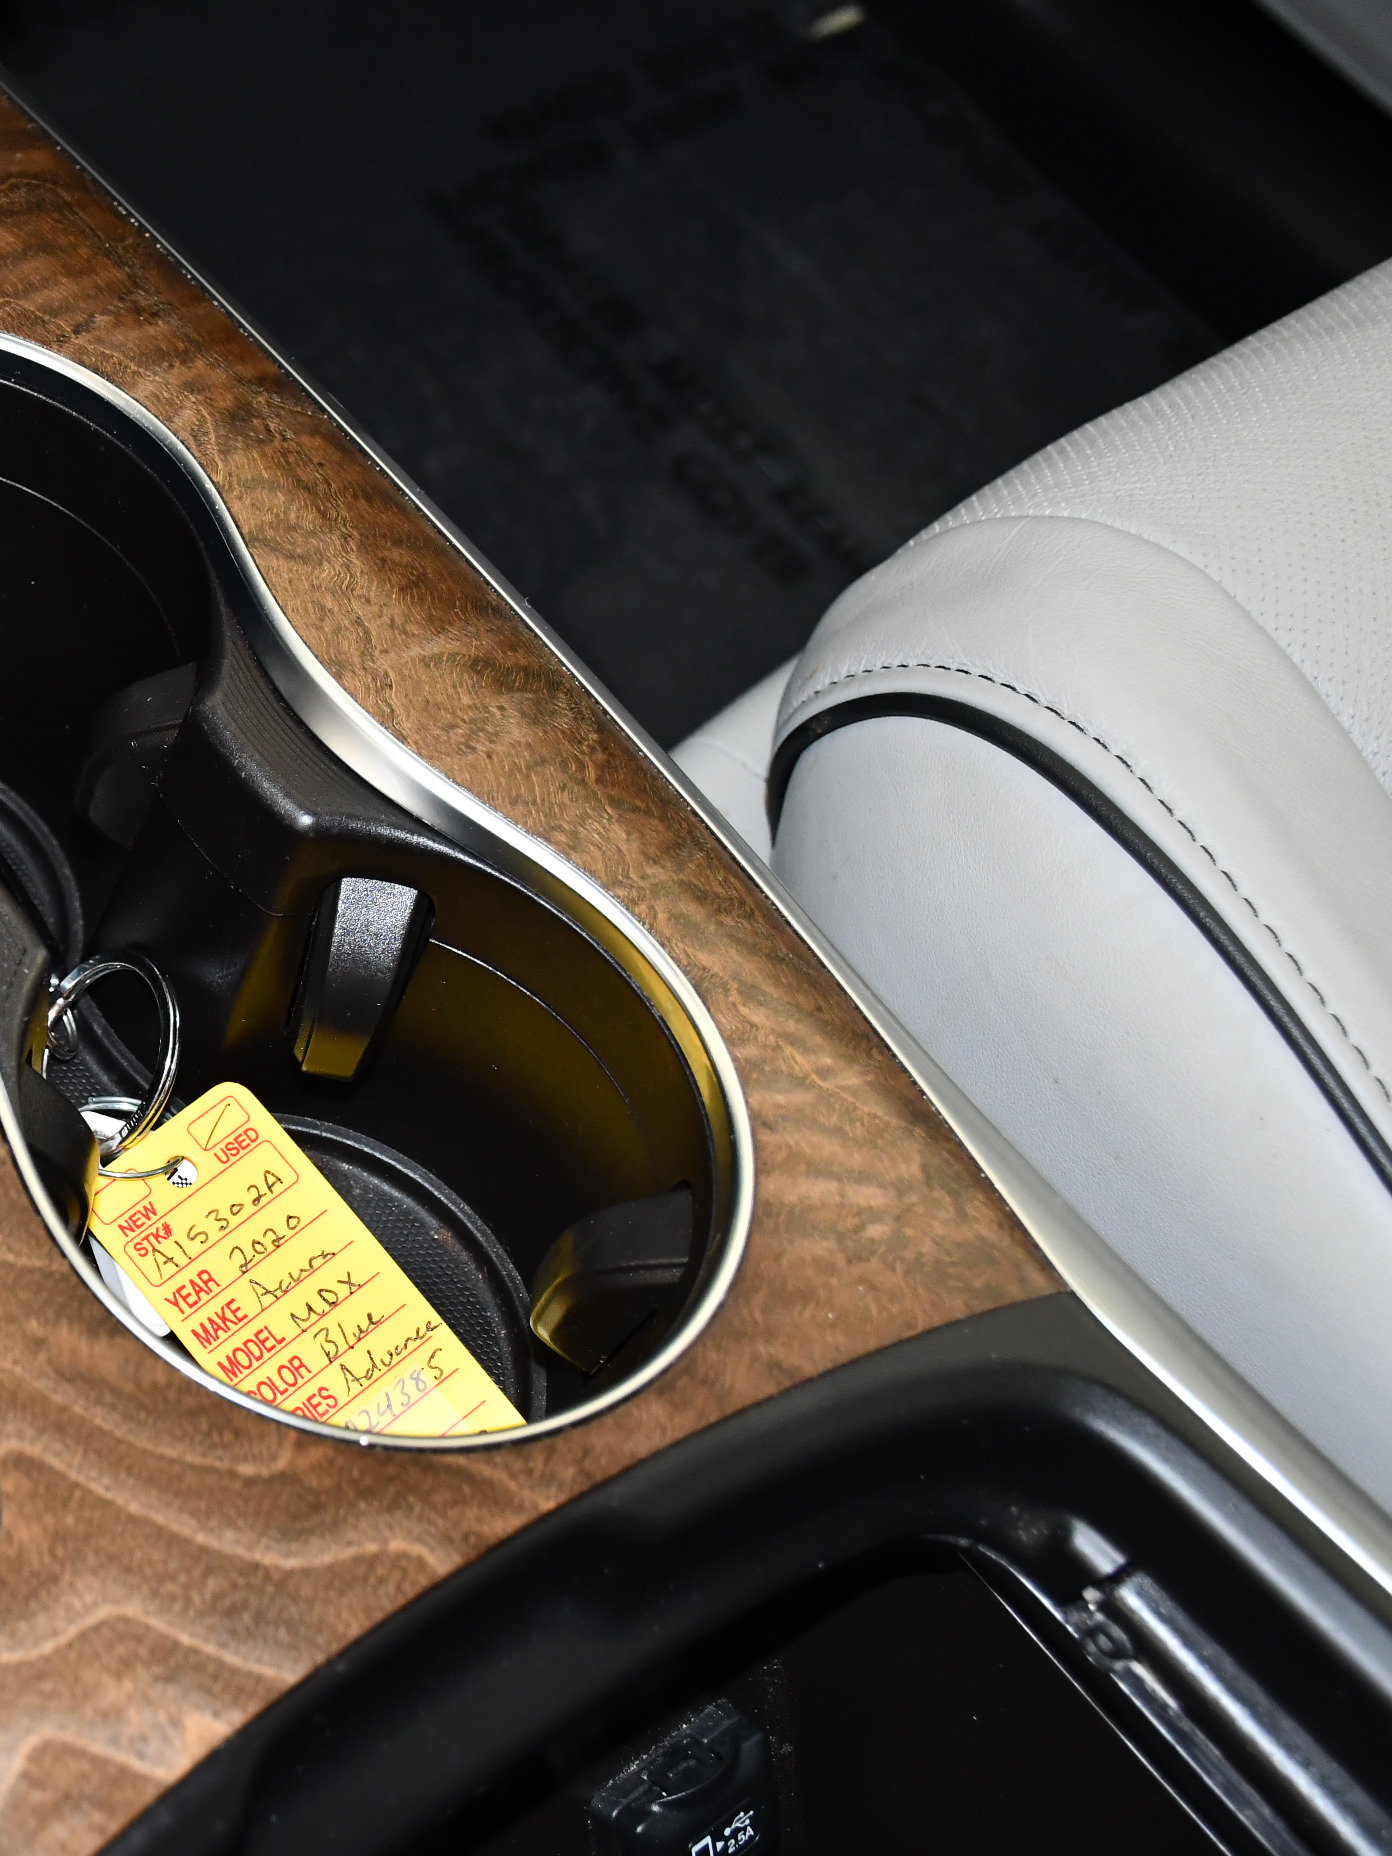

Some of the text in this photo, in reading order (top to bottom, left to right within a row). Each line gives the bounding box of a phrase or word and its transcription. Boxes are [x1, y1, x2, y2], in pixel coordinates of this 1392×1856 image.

[213, 1127, 259, 1165] USED
[117, 1201, 158, 1238] NEW
[133, 1220, 173, 1258] STK#
[229, 1214, 301, 1274] 2020
[164, 1269, 221, 1316] YEAR
[290, 1271, 361, 1332] MDX
[190, 1298, 248, 1350] MAKE
[313, 1312, 385, 1363] Blue
[216, 1325, 286, 1382] MODEL
[727, 1825, 755, 1854] 2.5A
